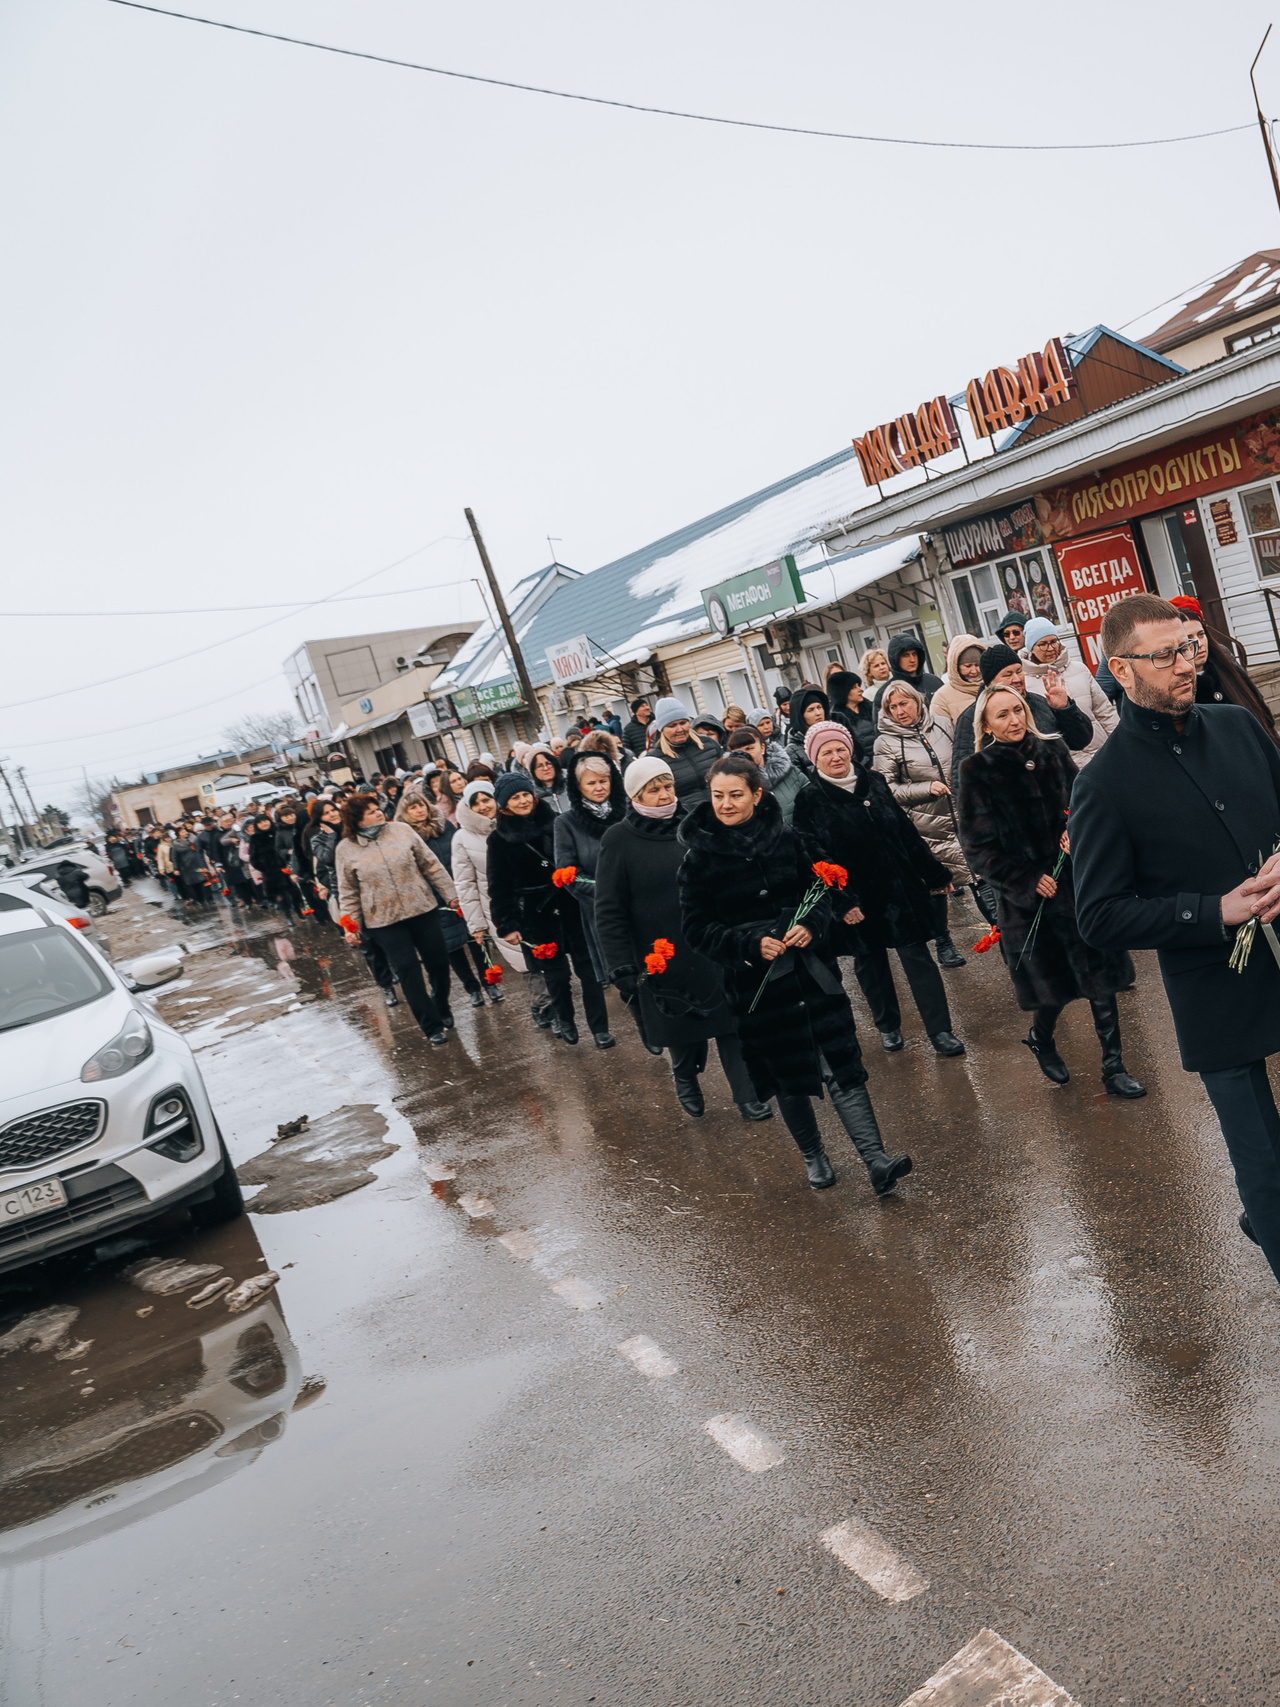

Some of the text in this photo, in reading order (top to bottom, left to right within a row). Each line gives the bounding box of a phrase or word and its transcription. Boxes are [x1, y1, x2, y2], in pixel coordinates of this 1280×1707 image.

[852, 337, 1073, 487] МЯСНАЯ ЛАВКА
[1072, 438, 1243, 525] МЯСОПРОДУКТЫ
[945, 517, 1005, 564] ШАУРМА
[999, 518, 1013, 538] НА
[1070, 556, 1134, 591] ВСЕГДА
[552, 652, 583, 680] МЯСО
[476, 687, 496, 702] ВСЕ
[21, 1182, 55, 1204] 123
